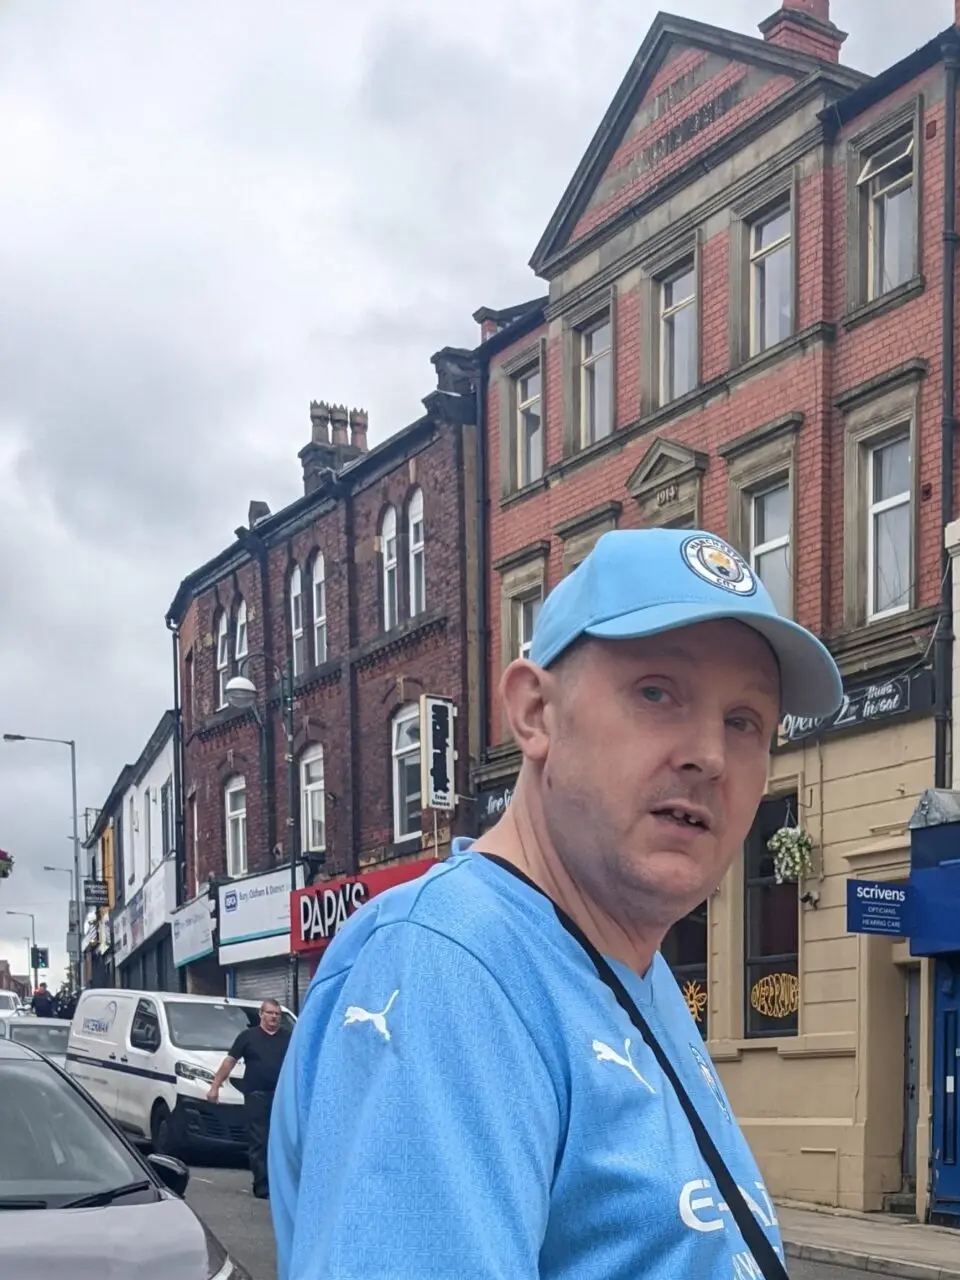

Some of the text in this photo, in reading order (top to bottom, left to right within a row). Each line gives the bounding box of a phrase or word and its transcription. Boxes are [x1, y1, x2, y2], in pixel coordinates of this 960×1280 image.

[431, 799, 450, 807] house
[856, 884, 906, 902] scrivens
[300, 882, 366, 942] PAPA'S
[867, 906, 897, 915] OPTICIANS
[862, 918, 901, 929] HEARING CARE
